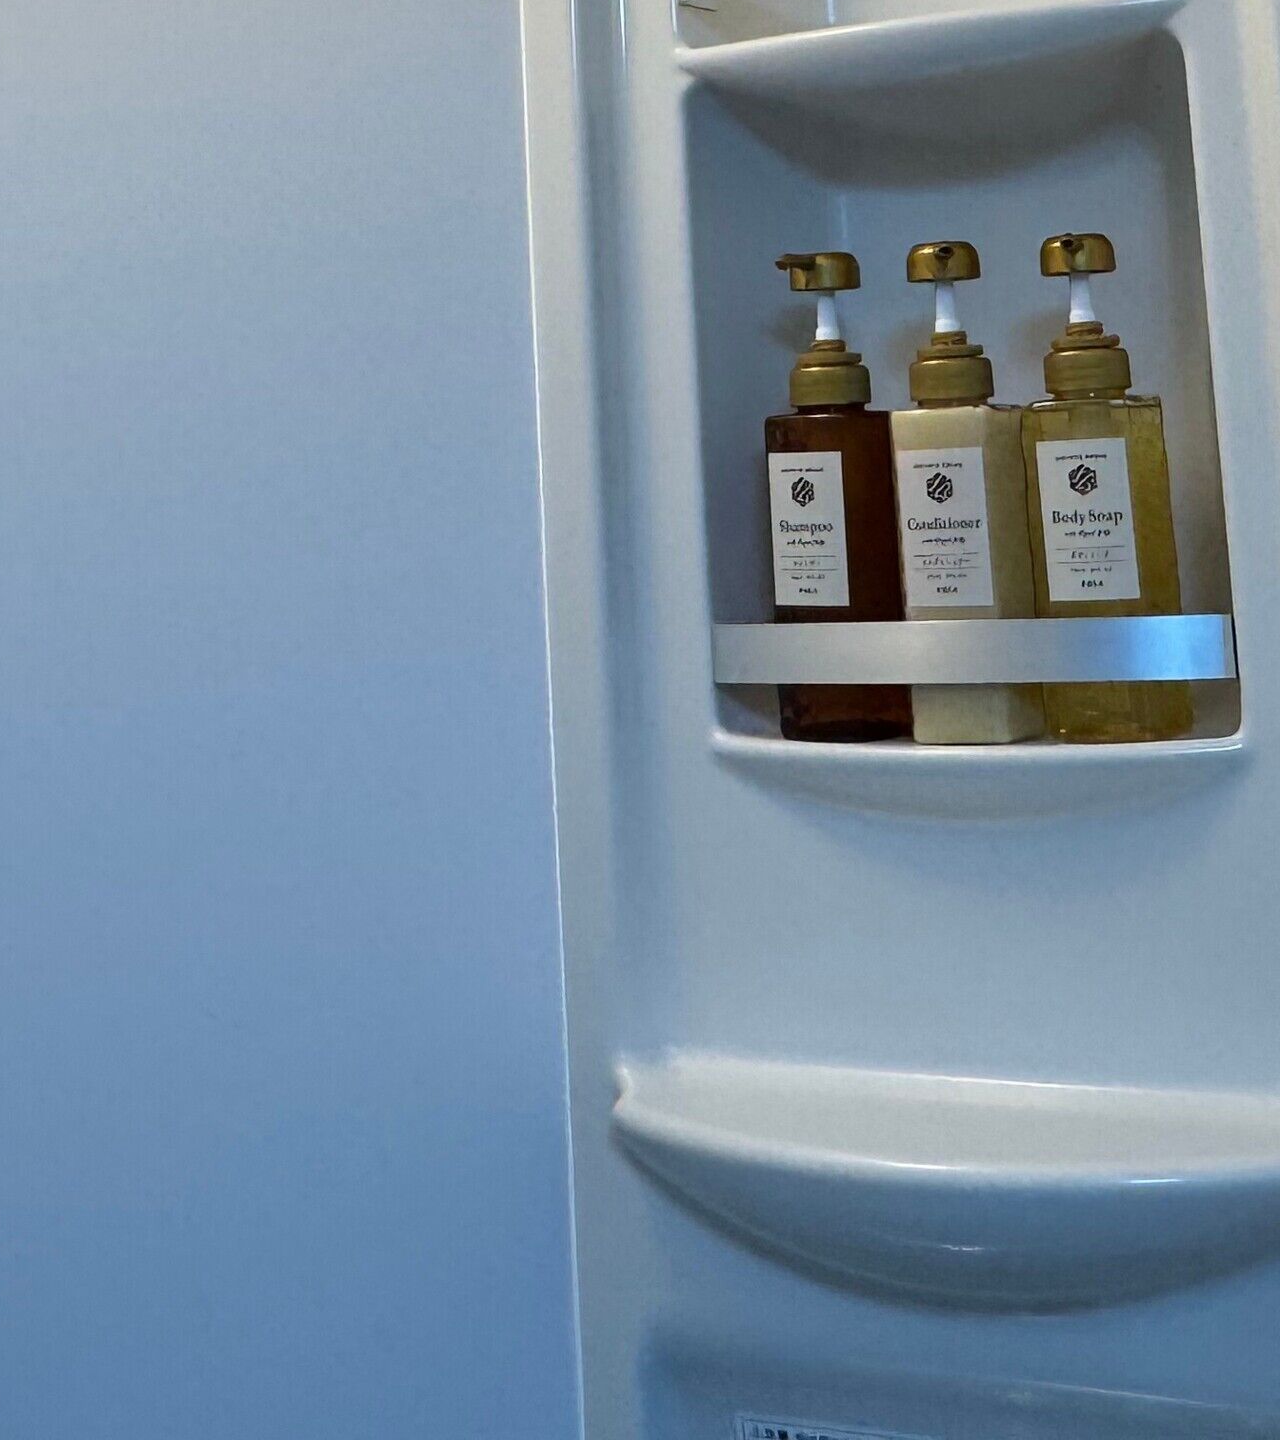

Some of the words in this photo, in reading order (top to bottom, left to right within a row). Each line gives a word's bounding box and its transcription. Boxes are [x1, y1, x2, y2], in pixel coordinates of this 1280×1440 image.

[1052, 509, 1085, 526] Body
[1089, 508, 1123, 526] Soap
[779, 519, 833, 537] Shampoo
